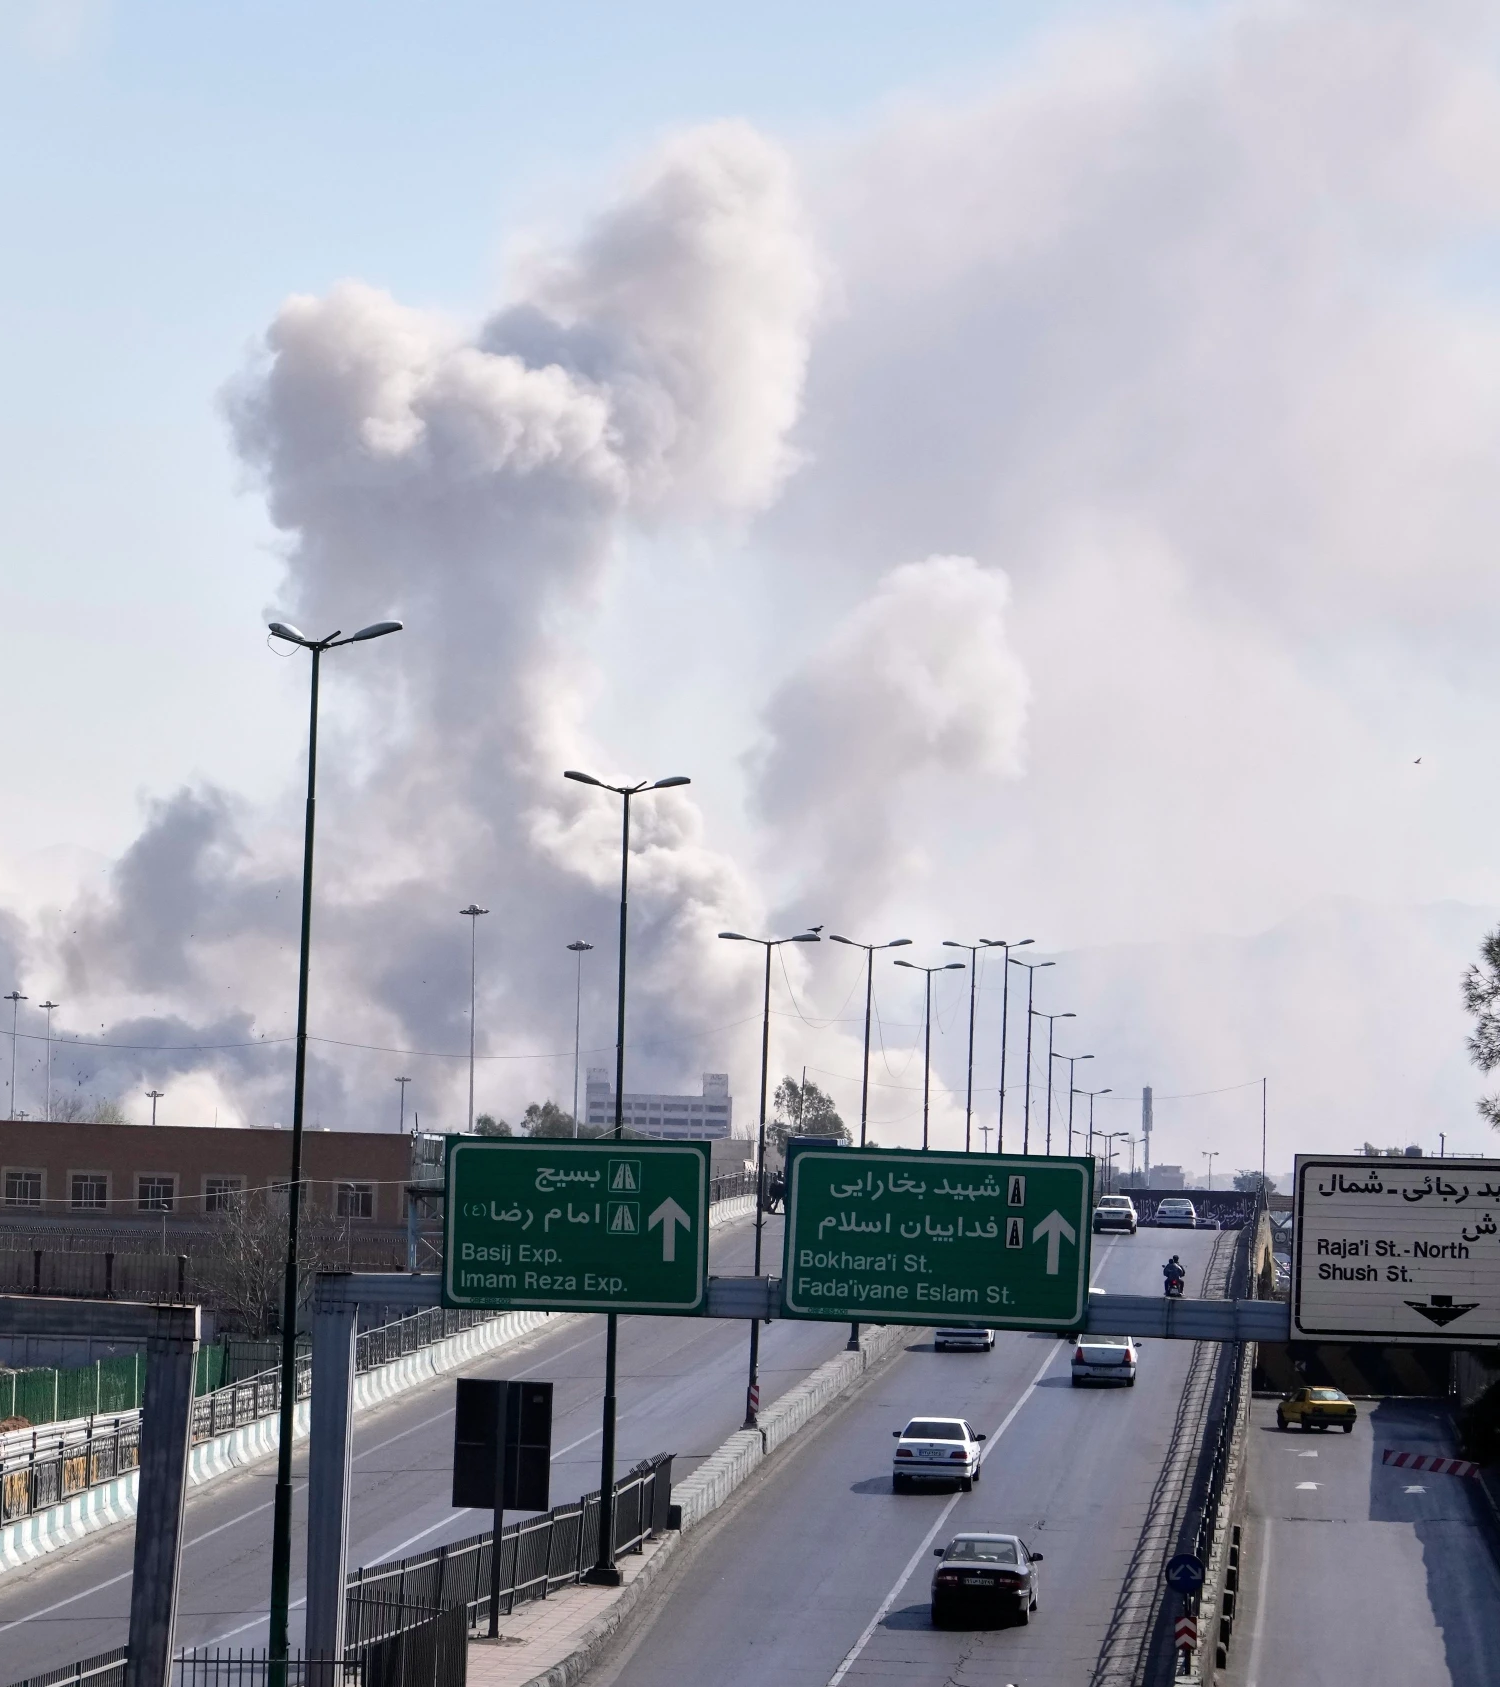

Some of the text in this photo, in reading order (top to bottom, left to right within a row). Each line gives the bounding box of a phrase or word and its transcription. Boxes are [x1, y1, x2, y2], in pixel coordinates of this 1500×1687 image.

[535, 1166, 600, 1192] بسیج
[830, 1171, 1000, 1201] شهید بخارایی
[544, 1203, 600, 1232] امام
[818, 1212, 998, 1242] فداییان اسلام
[461, 1243, 562, 1266] Basij Exp.
[1318, 1239, 1368, 1258] Raja'i
[800, 1250, 933, 1273] Bokhara'i St.
[1319, 1263, 1413, 1283] Shush St.
[461, 1270, 628, 1294] Imam Reza Exp.
[799, 1277, 1015, 1304] Fada'iyane Eslam St.
